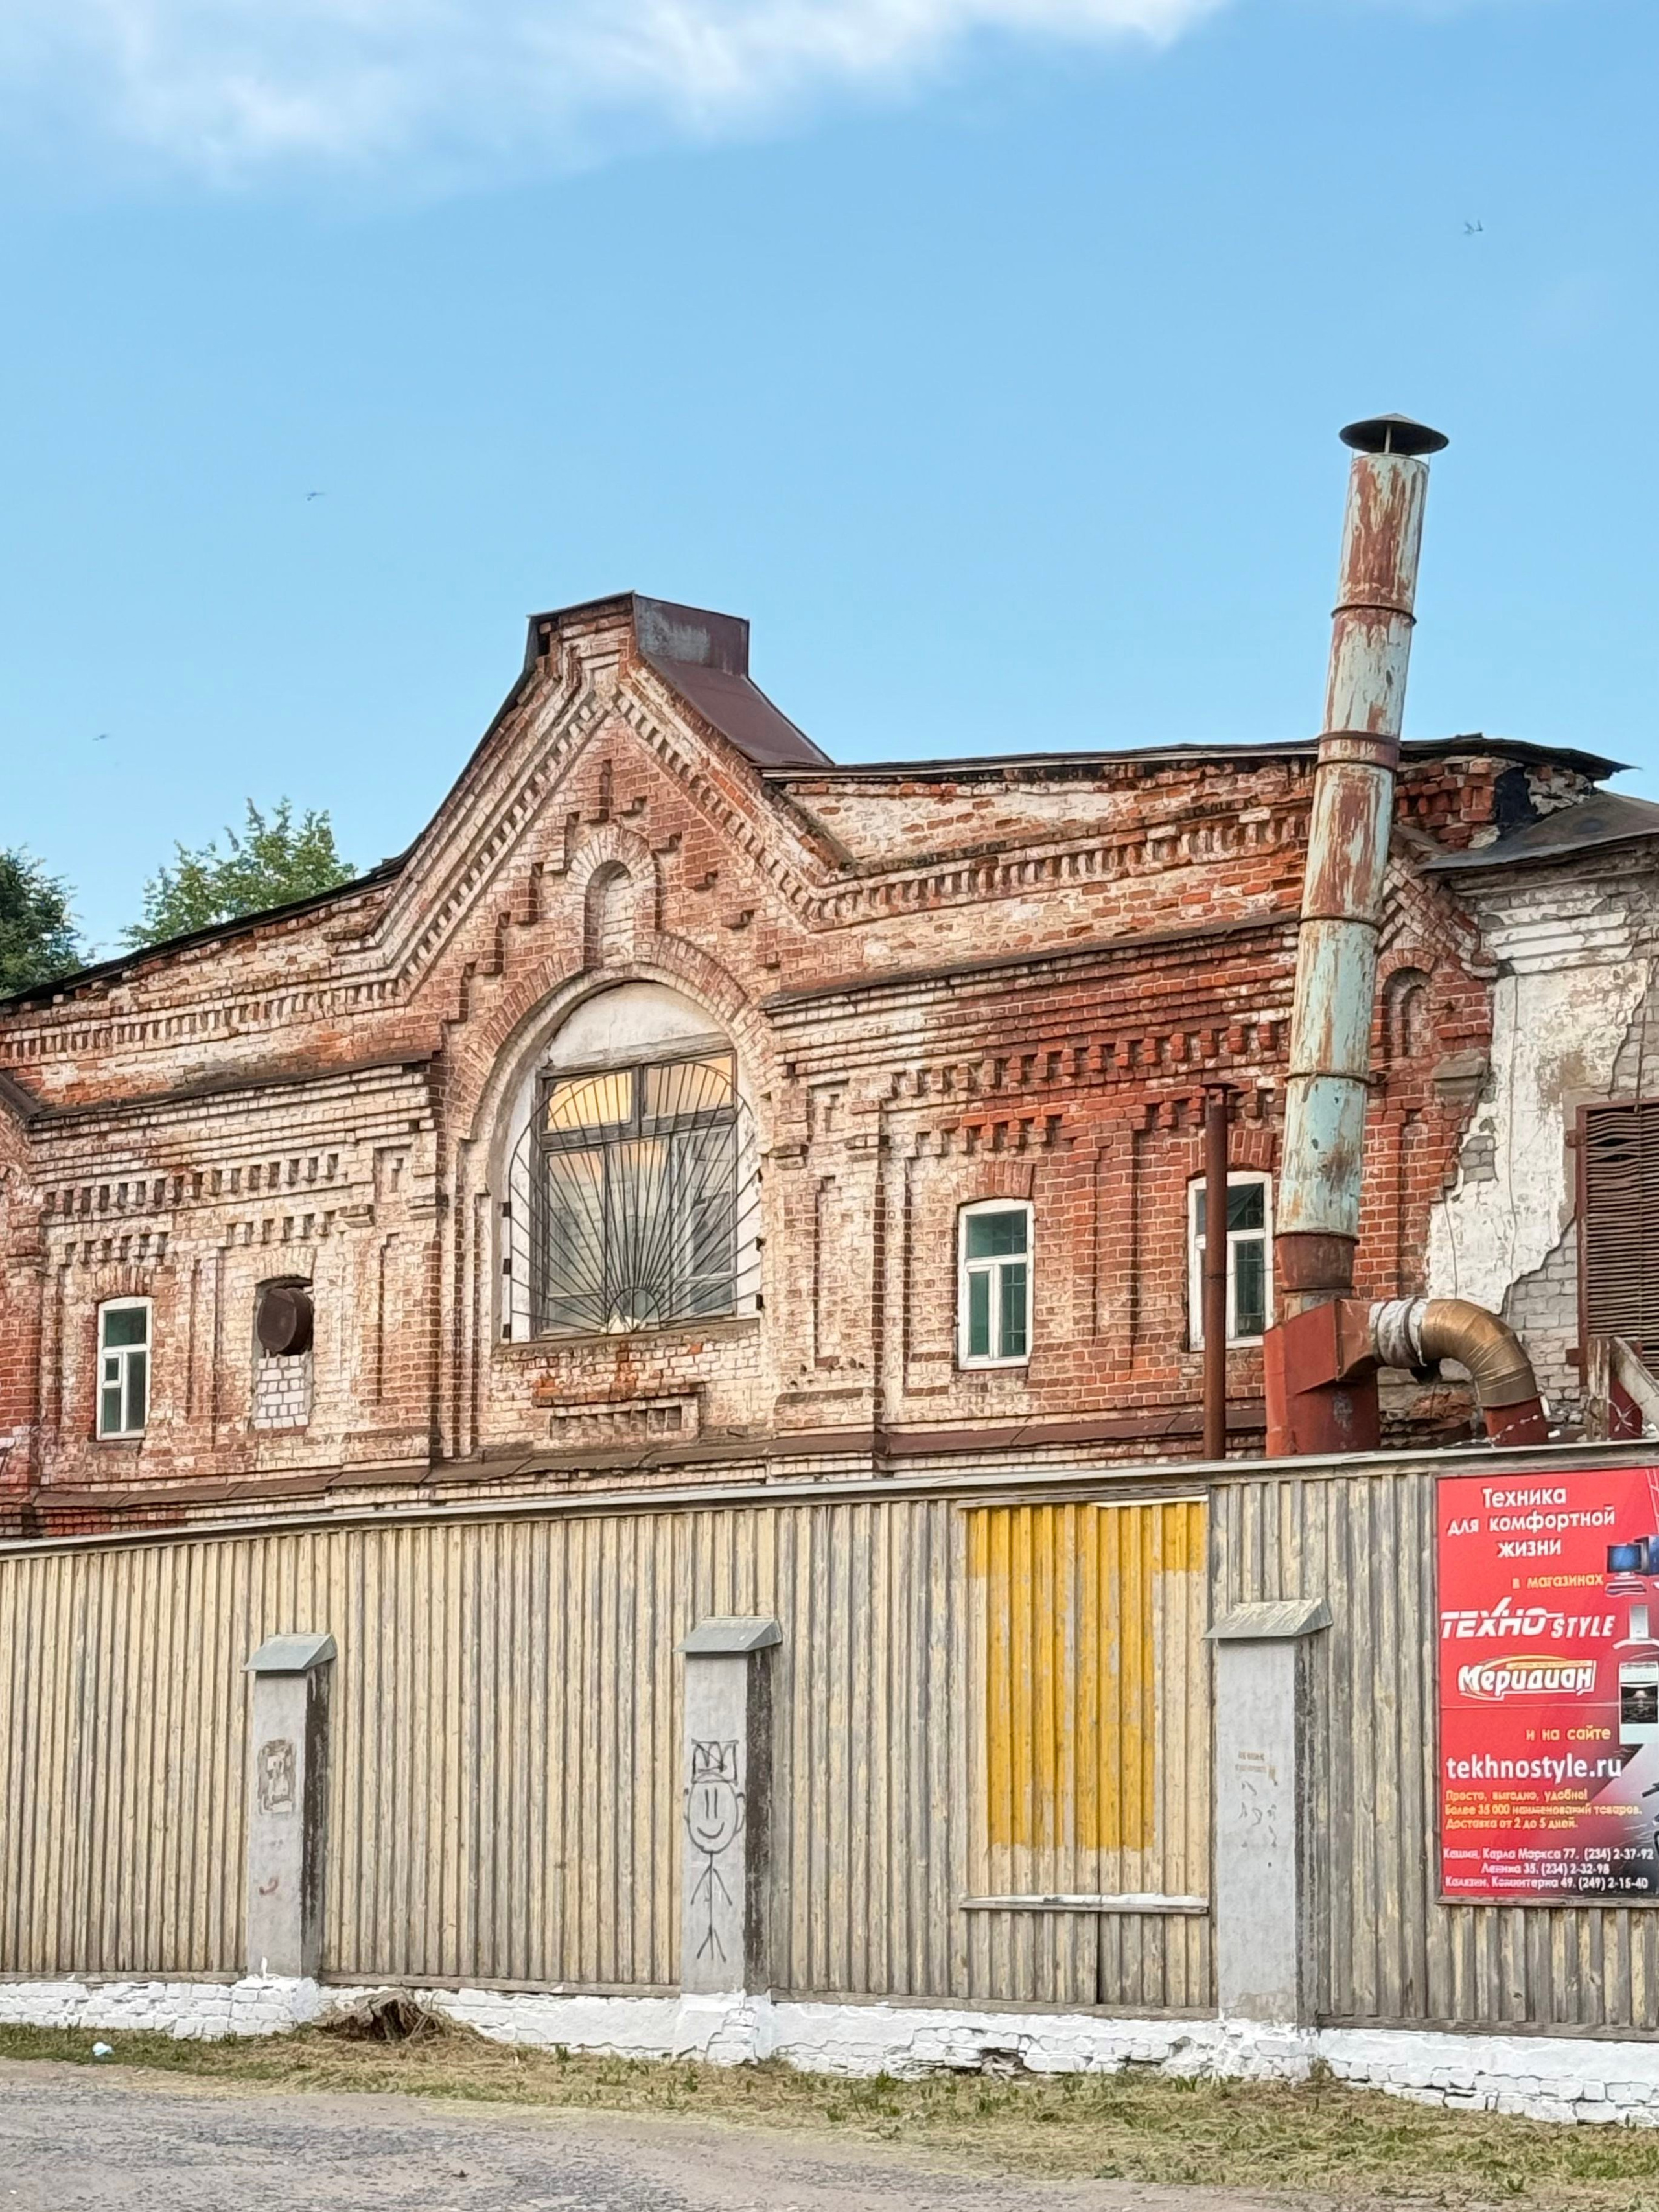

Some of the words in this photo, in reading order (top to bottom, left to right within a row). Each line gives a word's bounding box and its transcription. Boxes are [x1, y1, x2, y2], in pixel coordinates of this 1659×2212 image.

[1482, 1487, 1566, 1508] Техника
[1447, 1519, 1479, 1536] для
[1489, 1506, 1615, 1533] комфортной
[1497, 1539, 1562, 1558] жизни
[1513, 1578, 1520, 1589] в
[1527, 1574, 1604, 1589] магазинах
[1458, 1665, 1592, 1696] Меридиан
[1526, 1729, 1535, 1741] и
[1542, 1729, 1560, 1741] на
[1567, 1725, 1612, 1740] сайте
[1446, 1753, 1621, 1784] tekhnostyle.ru
[1446, 1789, 1487, 1802] Просто,
[1492, 1791, 1540, 1802] выгодно,
[1544, 1788, 1588, 1802] удобно!
[1444, 1804, 1476, 1815] Более
[1492, 1804, 1511, 1815] 000
[1594, 1806, 1643, 1816] товаров.
[1445, 1818, 1498, 1830] Доставка
[1499, 1819, 1513, 1829] от
[1514, 1817, 1521, 1828] 2
[1523, 1819, 1537, 1830] до
[1539, 1817, 1546, 1829] 5
[1483, 1848, 1516, 1861] Карла
[1518, 1848, 1562, 1861] Маркса
[1584, 1848, 1611, 1862] (234)
[1613, 1848, 1654, 1860] 2-37-92
[1480, 1862, 1522, 1874] Ленина
[1541, 1863, 1568, 1876] (234)
[1570, 1863, 1610, 1874] 2-32-98
[1578, 1877, 1606, 1891] (249)
[1608, 1877, 1649, 1889] 2-15-40
